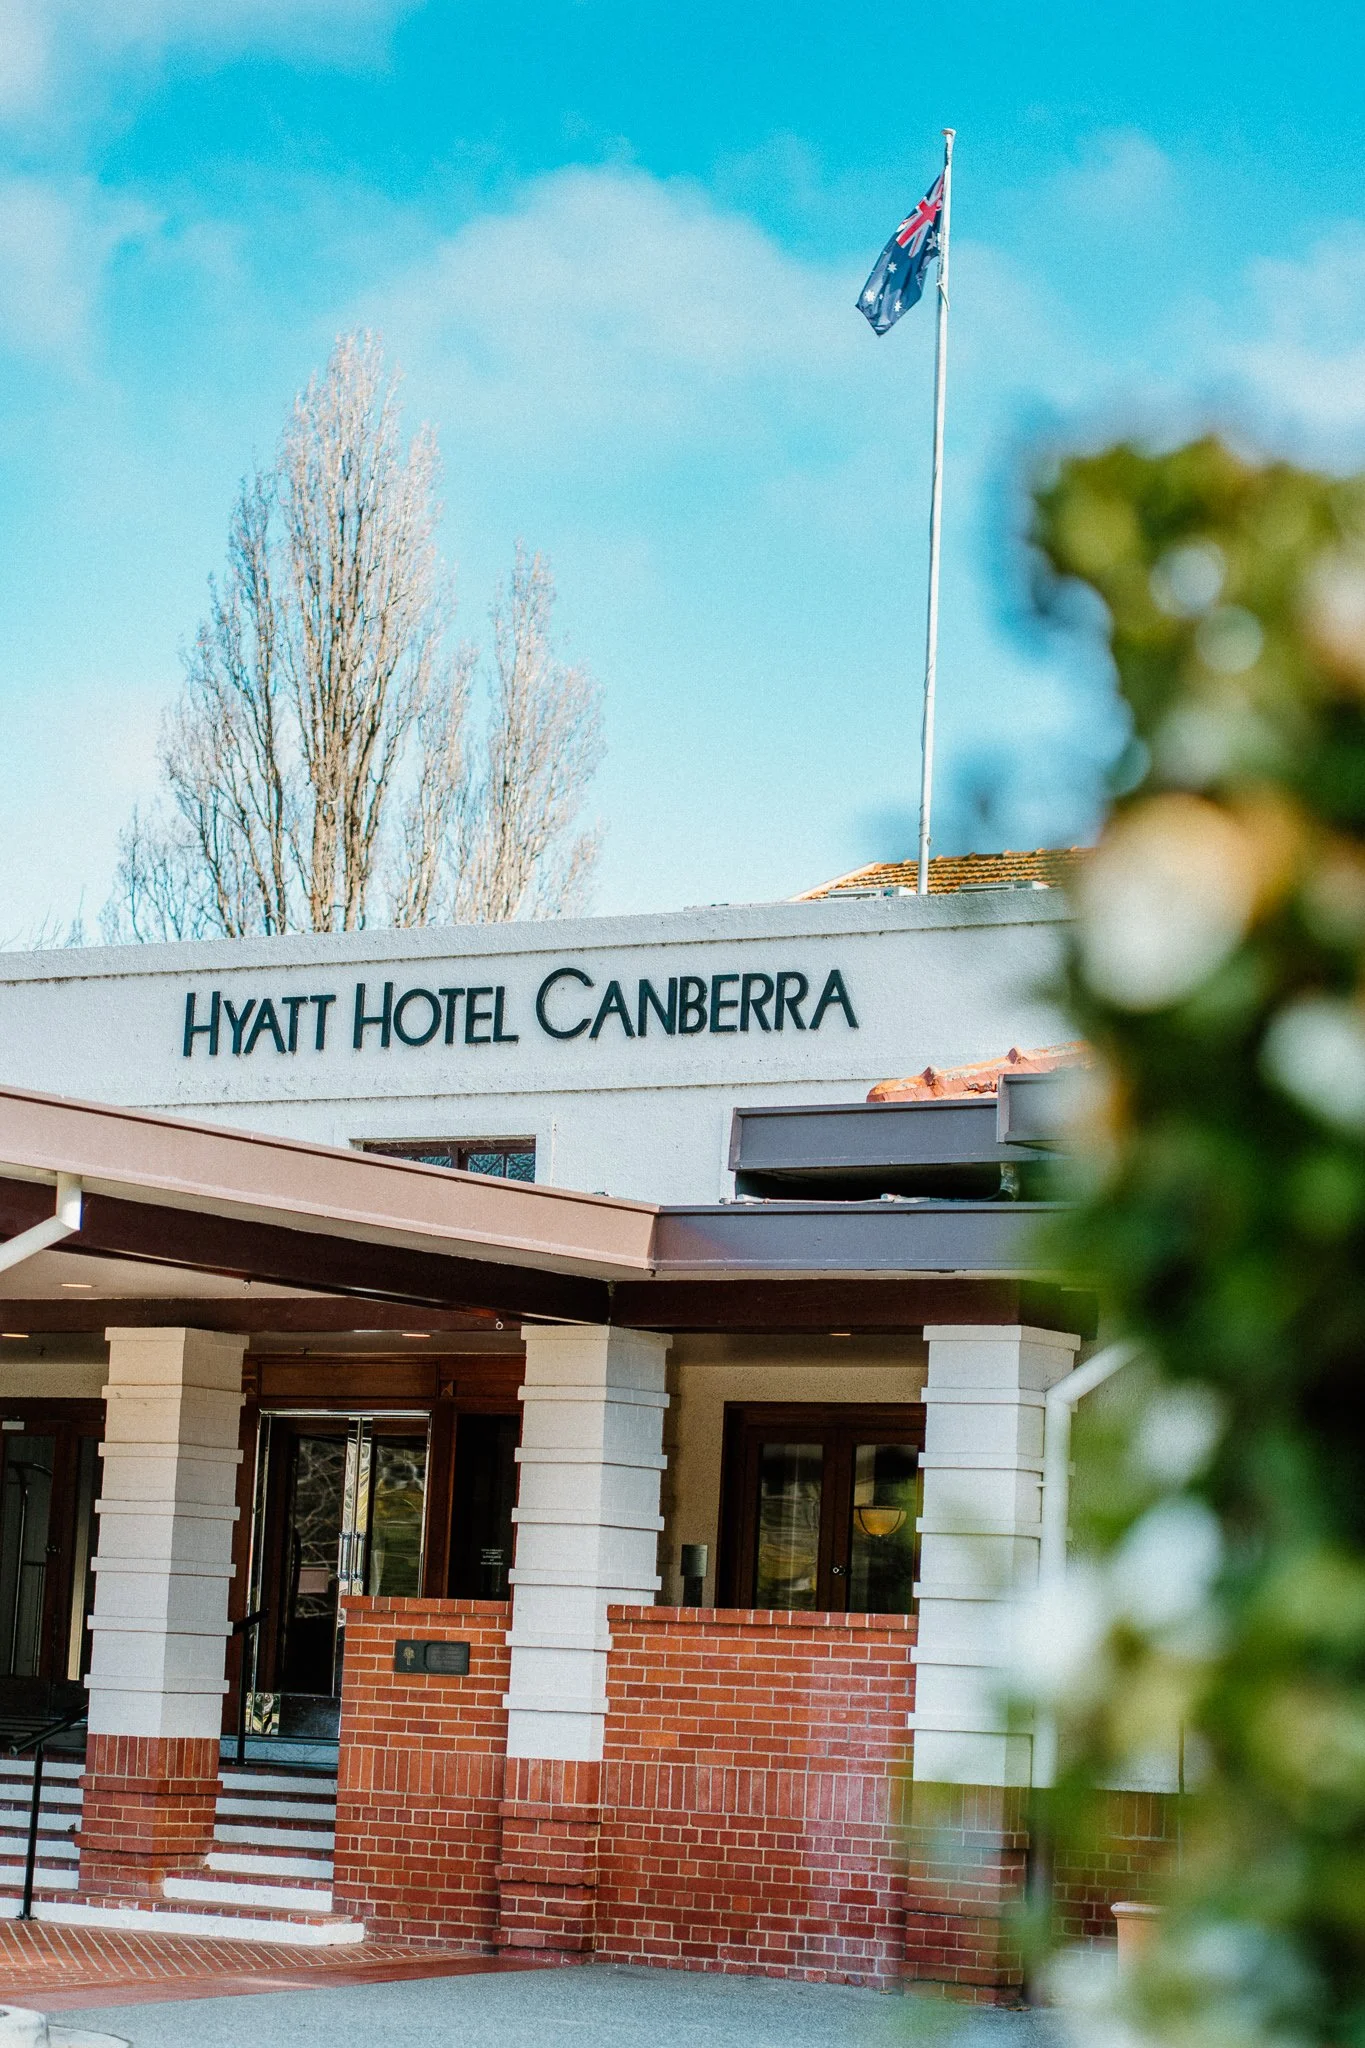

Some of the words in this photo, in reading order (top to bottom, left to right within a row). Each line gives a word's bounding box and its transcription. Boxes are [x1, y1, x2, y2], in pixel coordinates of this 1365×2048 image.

[183, 990, 337, 1058] HYATT
[352, 981, 520, 1049] HOTEL
[535, 967, 860, 1040] CANBERRA
